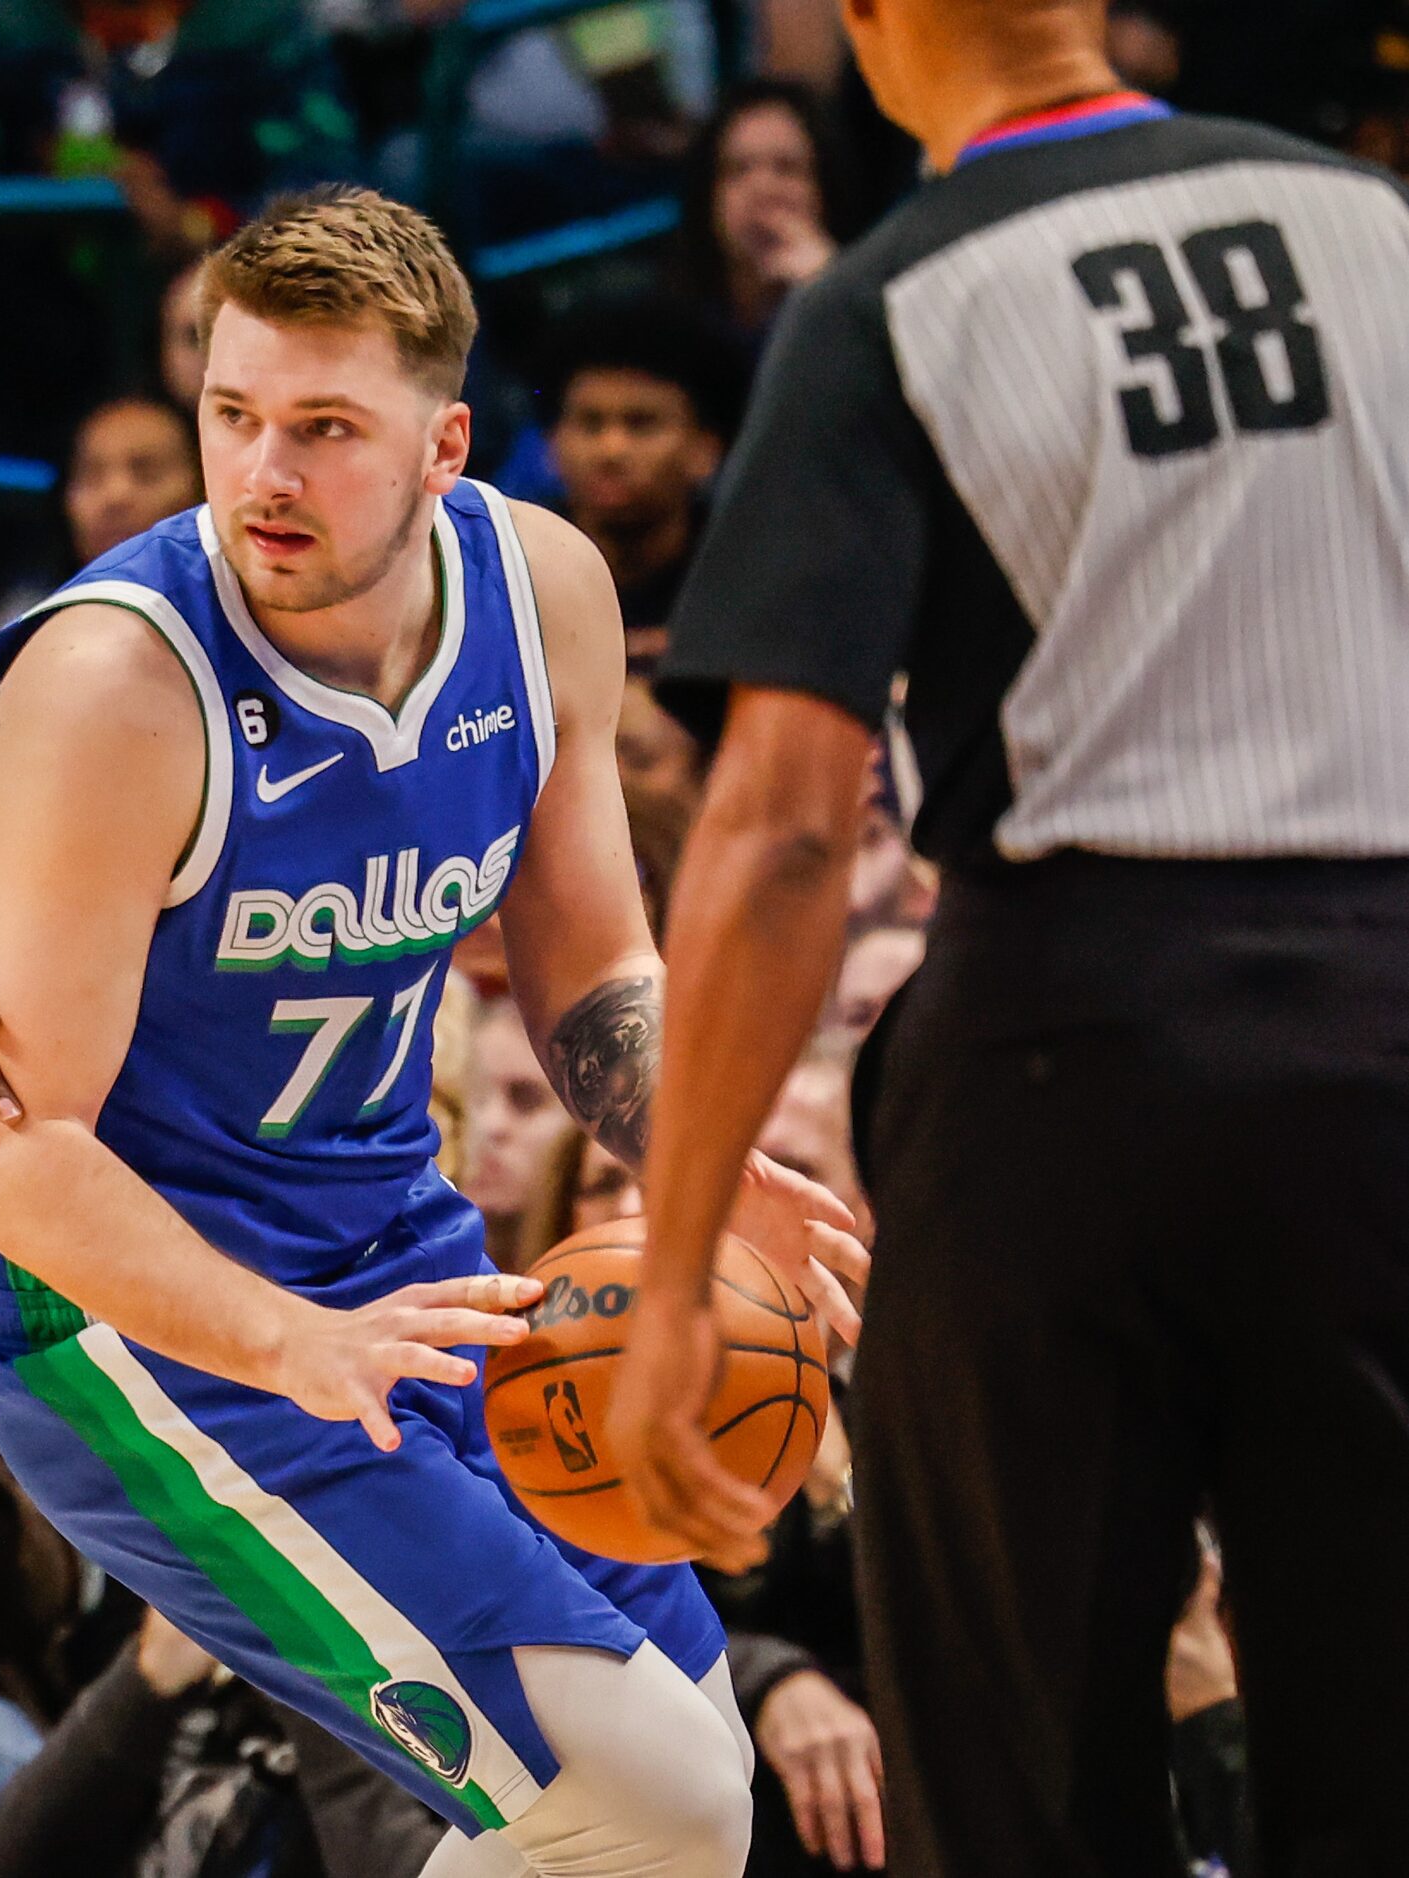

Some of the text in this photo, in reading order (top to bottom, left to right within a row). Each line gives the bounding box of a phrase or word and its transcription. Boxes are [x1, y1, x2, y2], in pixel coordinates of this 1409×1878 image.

[1070, 220, 1330, 457] 38
[236, 698, 269, 745] 6
[446, 705, 516, 752] chime
[214, 825, 521, 968] Dallas
[258, 960, 438, 1137] 77
